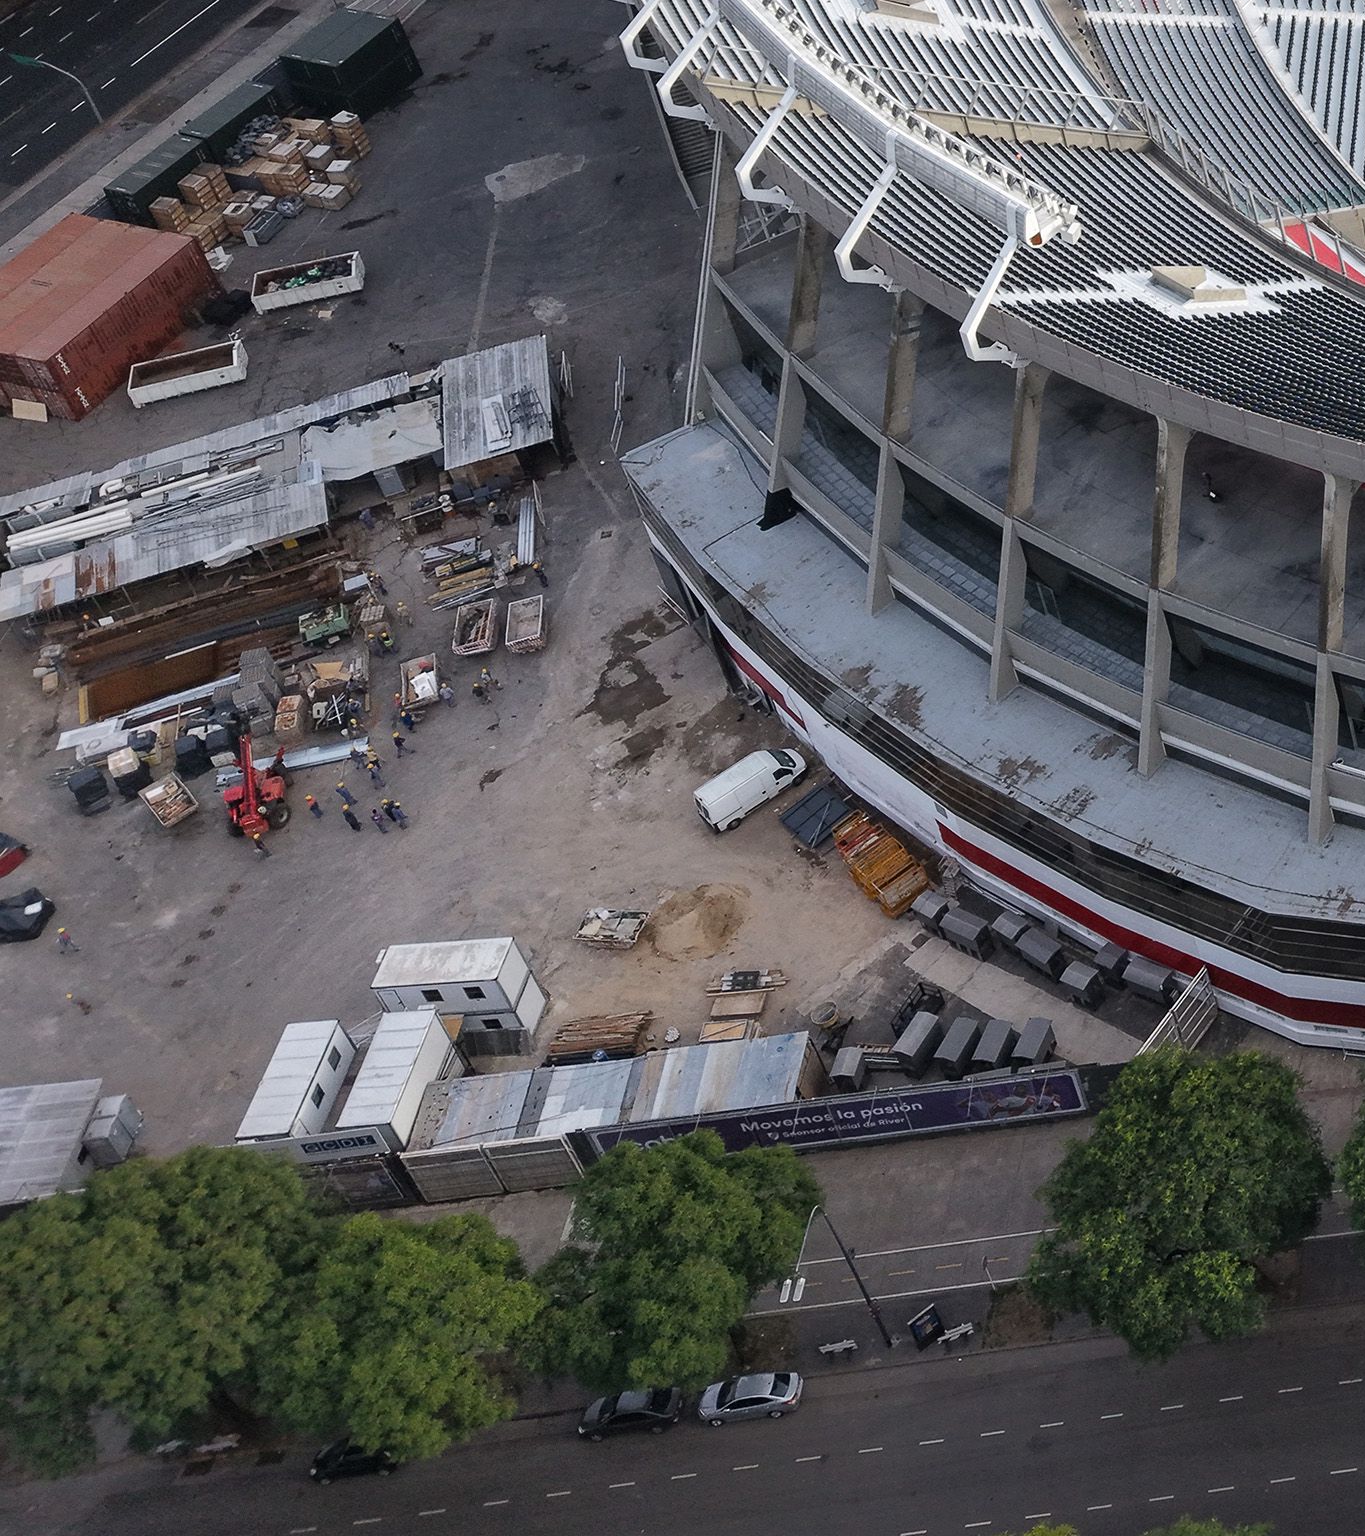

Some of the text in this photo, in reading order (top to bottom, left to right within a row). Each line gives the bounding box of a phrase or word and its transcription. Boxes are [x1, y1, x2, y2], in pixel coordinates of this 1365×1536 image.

[740, 1101, 924, 1132] Movemos la pasión
[782, 1127, 826, 1139] Sponsor
[878, 1116, 906, 1127] River
